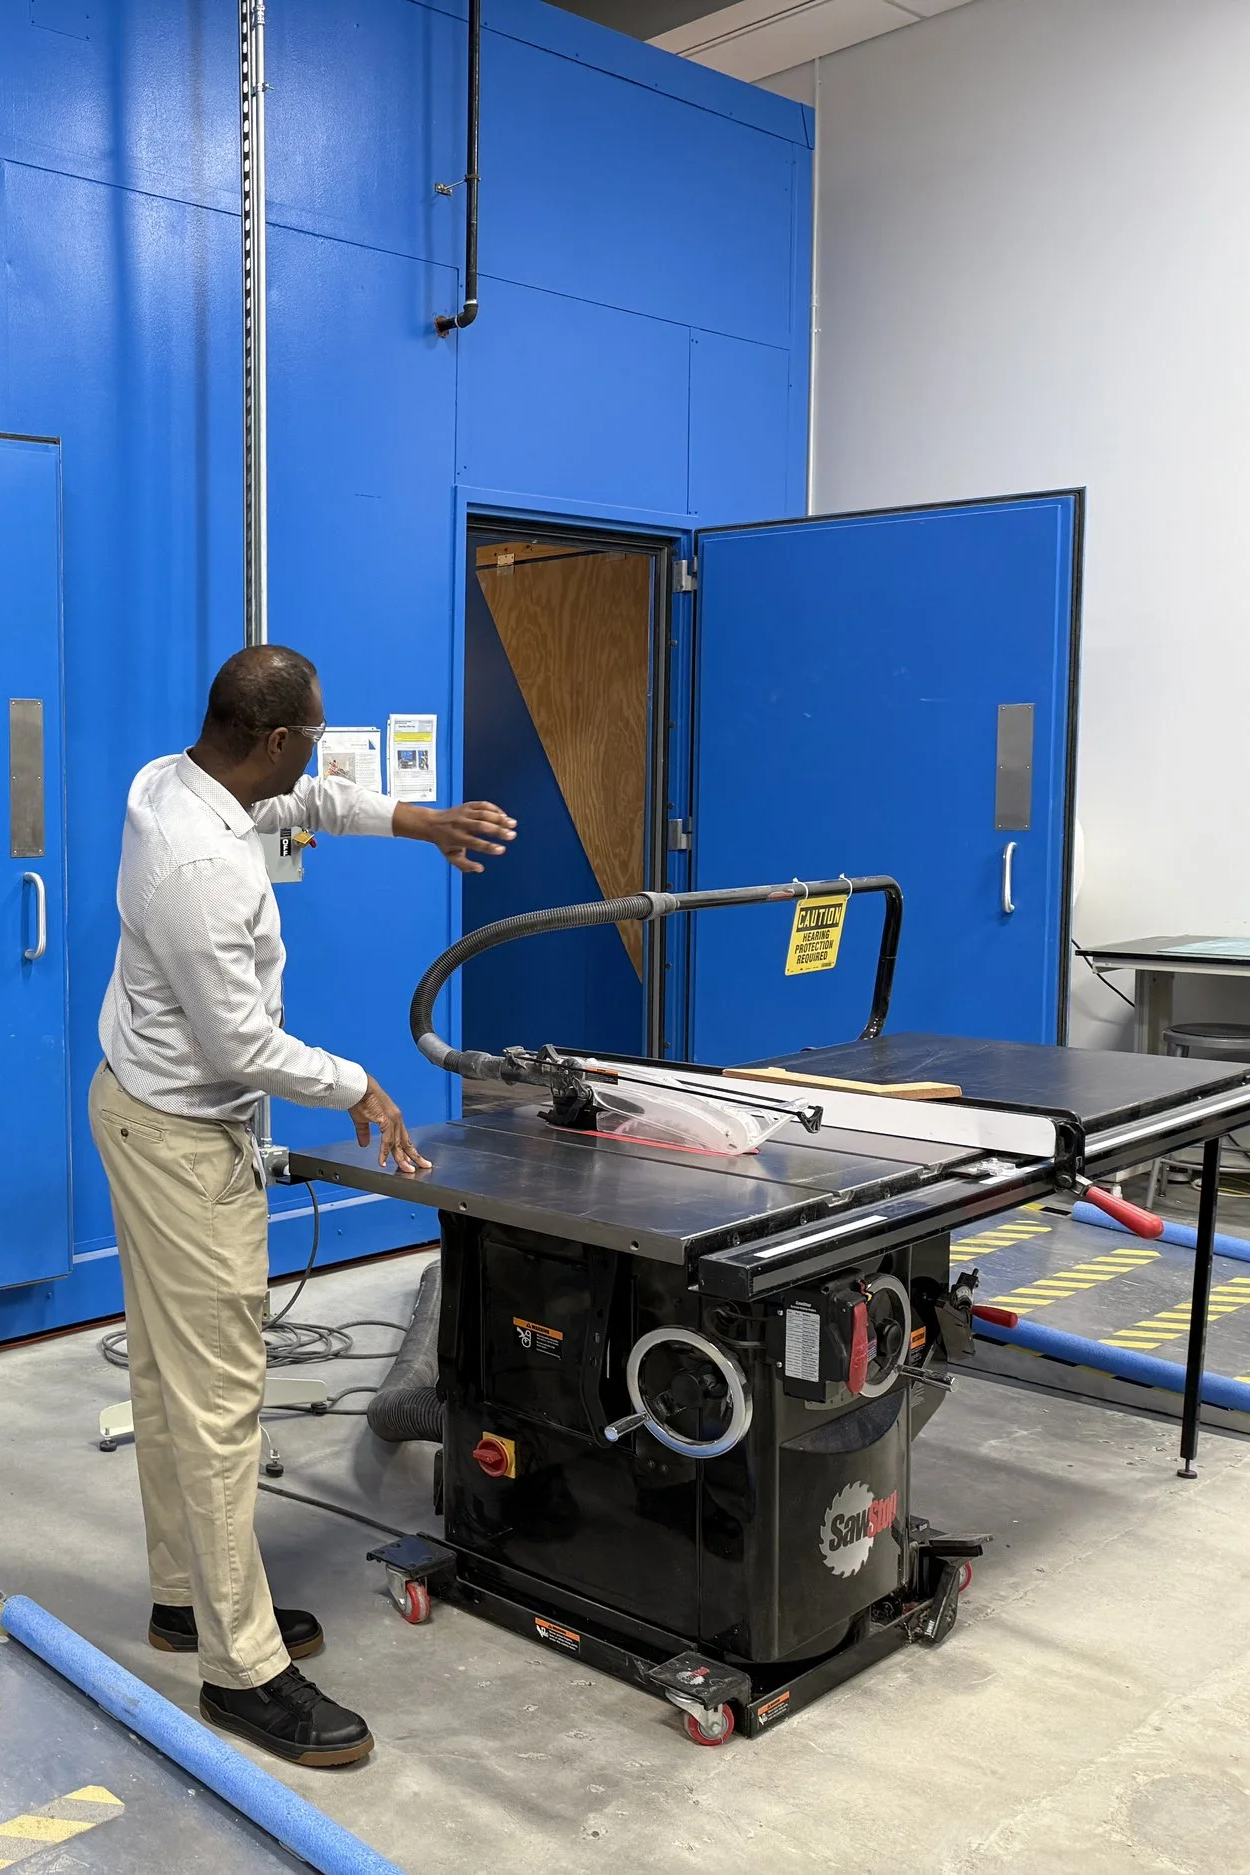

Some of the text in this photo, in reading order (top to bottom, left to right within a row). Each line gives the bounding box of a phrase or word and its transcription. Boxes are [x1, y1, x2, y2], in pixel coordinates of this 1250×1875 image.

[797, 906, 842, 928] CAUTION
[802, 929, 830, 943] HEARING
[794, 939, 834, 955] PROTECTION
[796, 950, 829, 965] REQUIRED
[828, 1489, 899, 1552] SawStop
